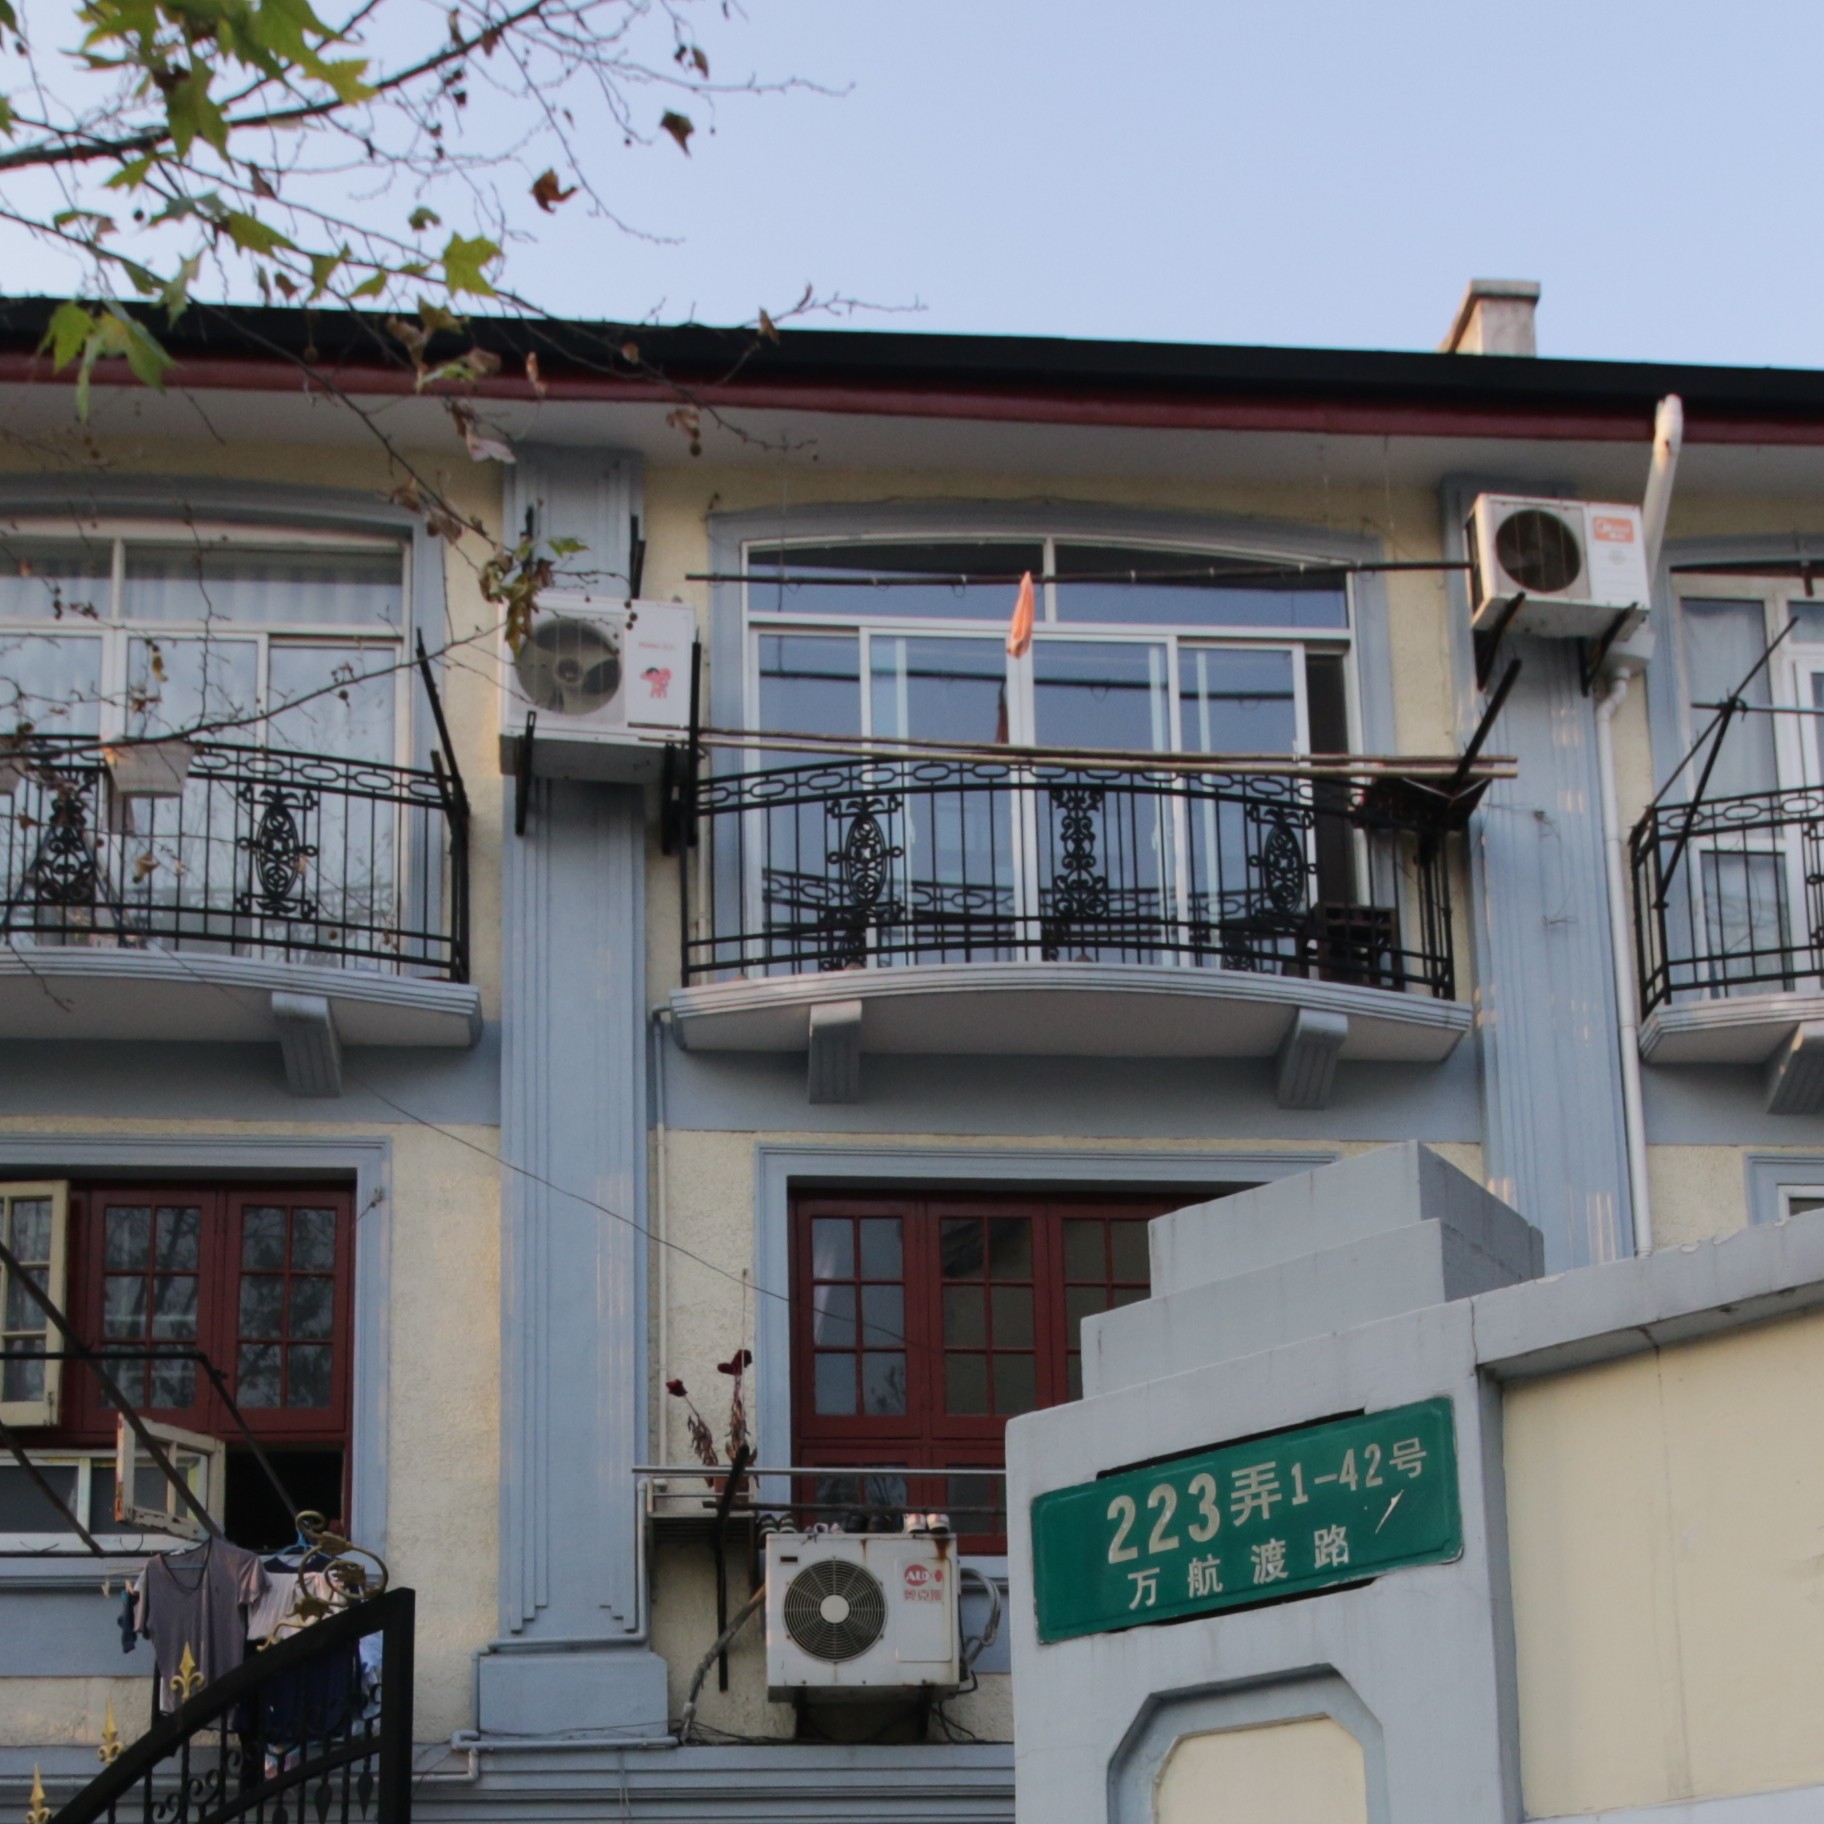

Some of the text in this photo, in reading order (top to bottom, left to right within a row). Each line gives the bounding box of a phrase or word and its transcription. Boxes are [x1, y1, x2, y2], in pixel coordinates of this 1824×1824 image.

[1107, 1437, 1427, 1564] 223弄1-42号
[1128, 1524, 1350, 1610] 万航渡路
